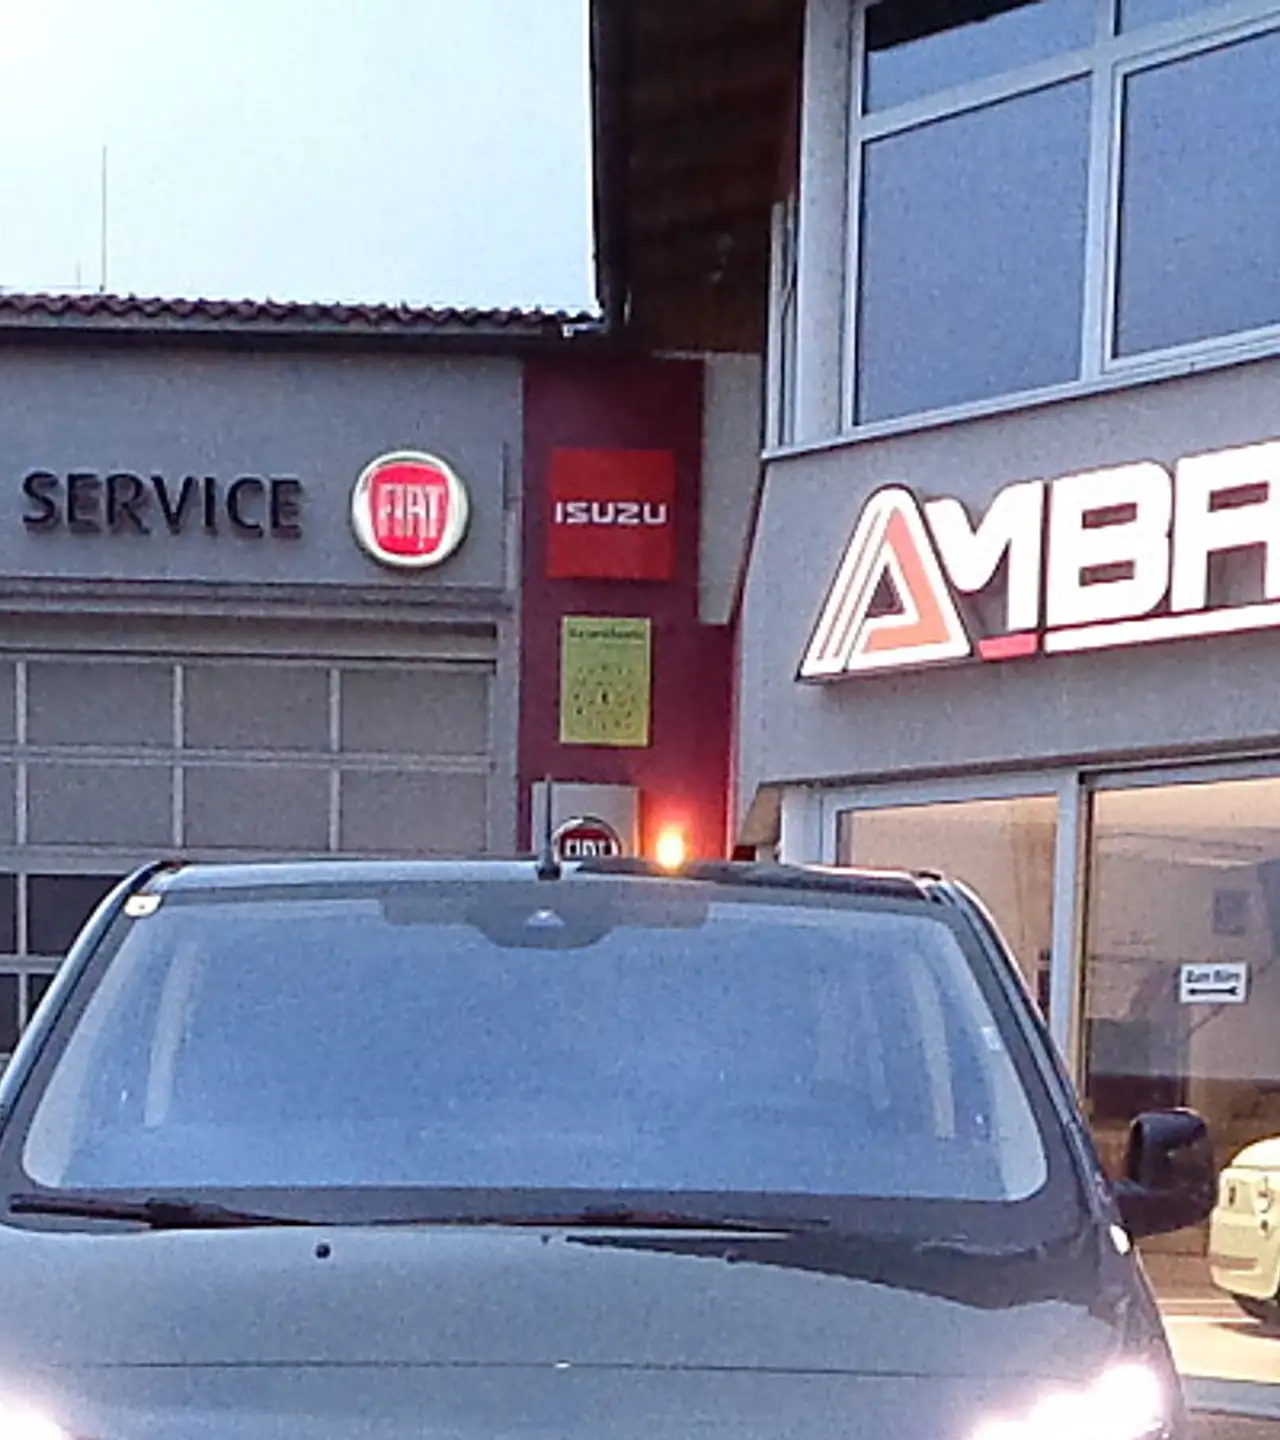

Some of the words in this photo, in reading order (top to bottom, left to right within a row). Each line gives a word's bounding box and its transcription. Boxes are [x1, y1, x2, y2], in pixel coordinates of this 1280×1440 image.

[22, 471, 304, 540] SERVICE
[377, 482, 446, 541] FIAT
[555, 501, 667, 526] ISUZU
